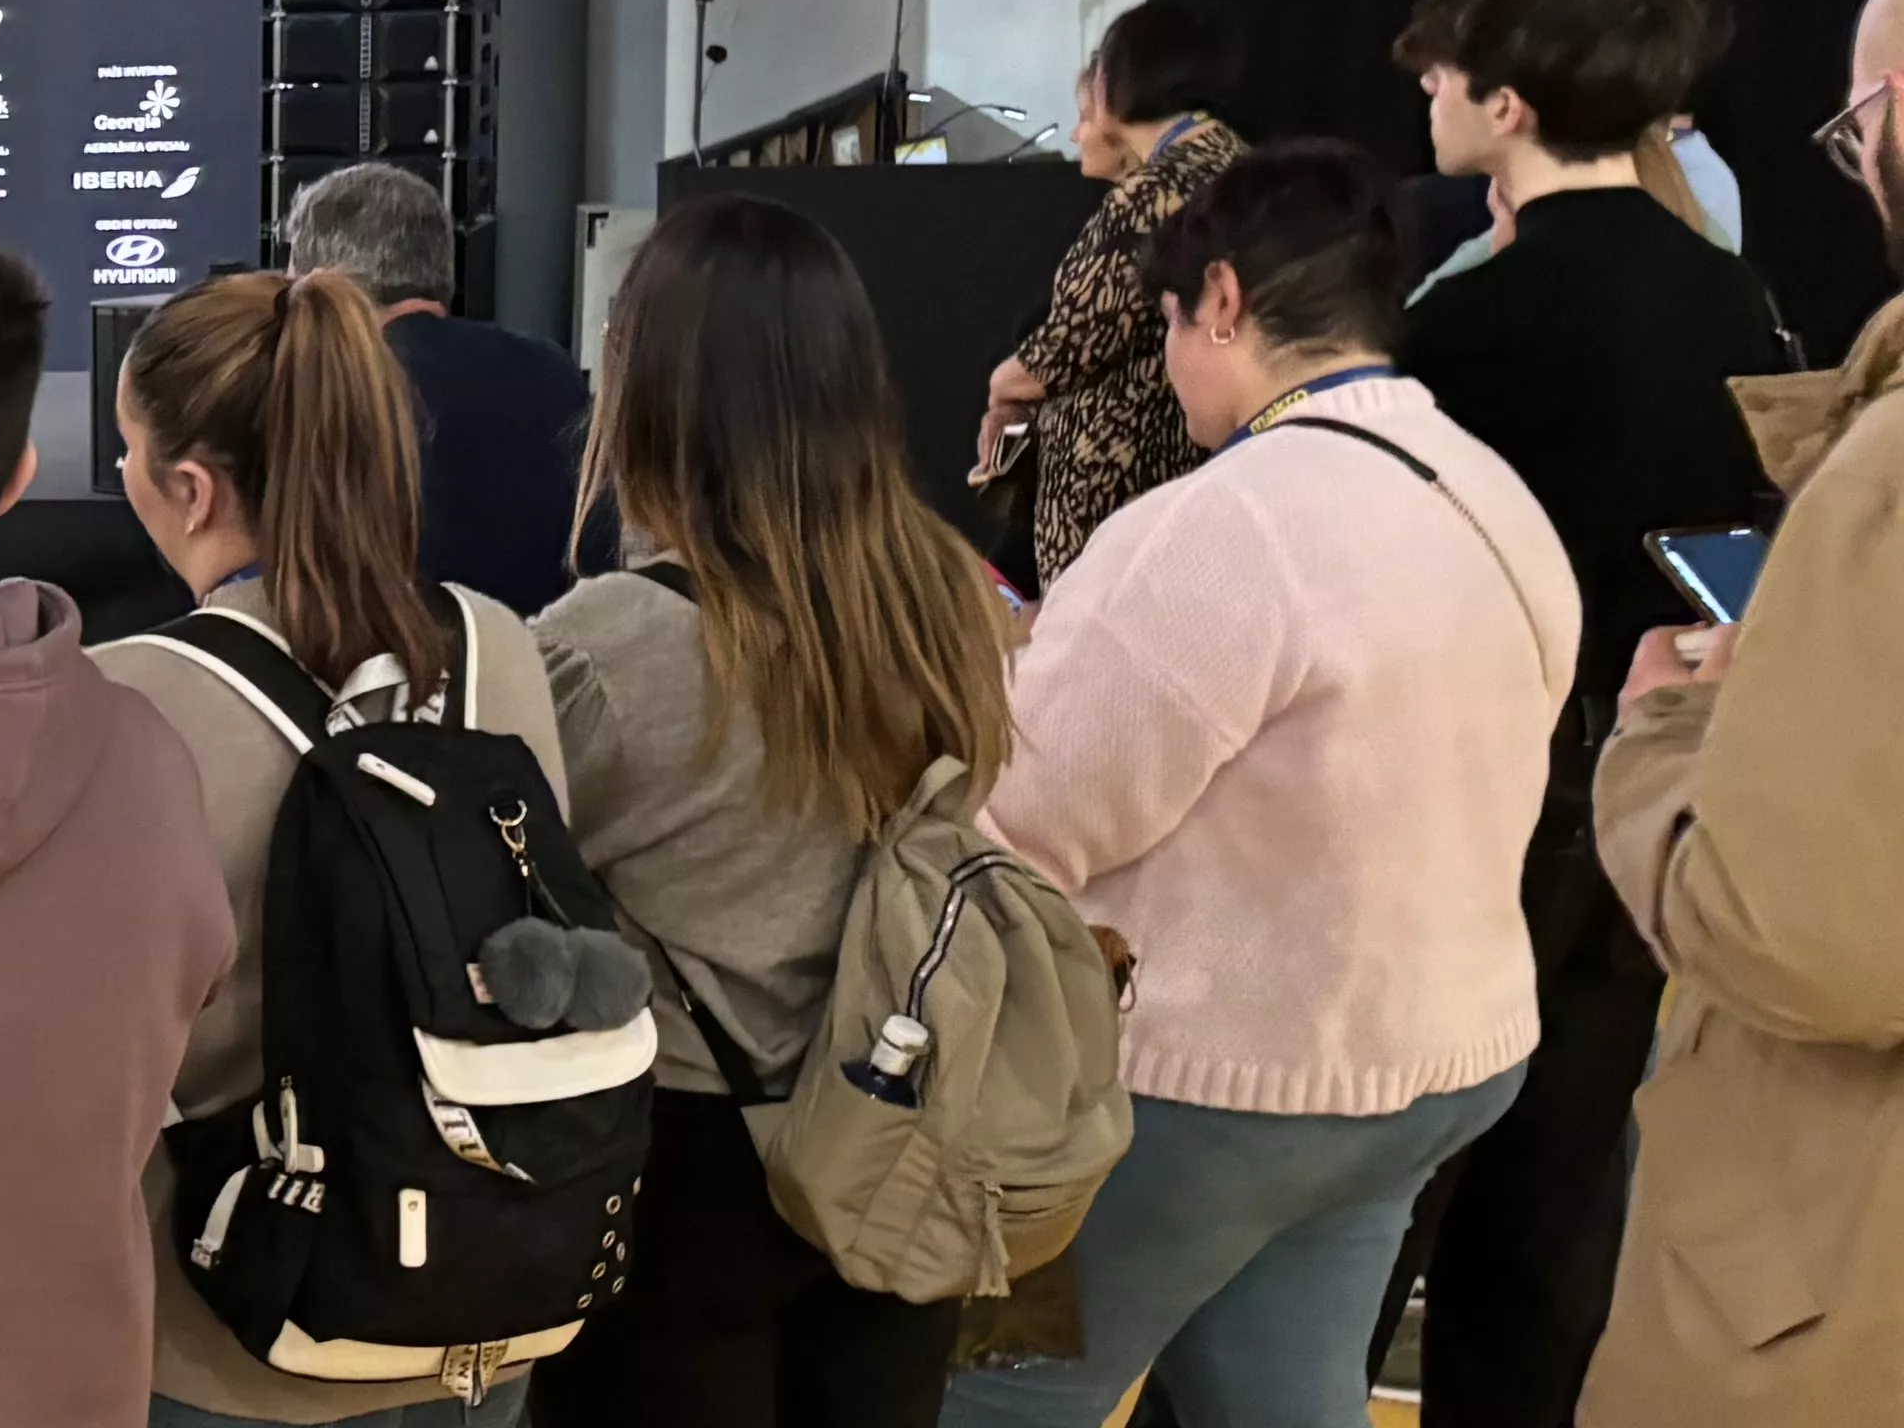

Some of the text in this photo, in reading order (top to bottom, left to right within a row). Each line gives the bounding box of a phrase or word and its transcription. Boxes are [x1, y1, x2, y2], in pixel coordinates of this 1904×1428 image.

[93, 114, 161, 132] Georgia
[73, 170, 163, 190] IBERIA
[93, 268, 176, 285] HYUNDAI
